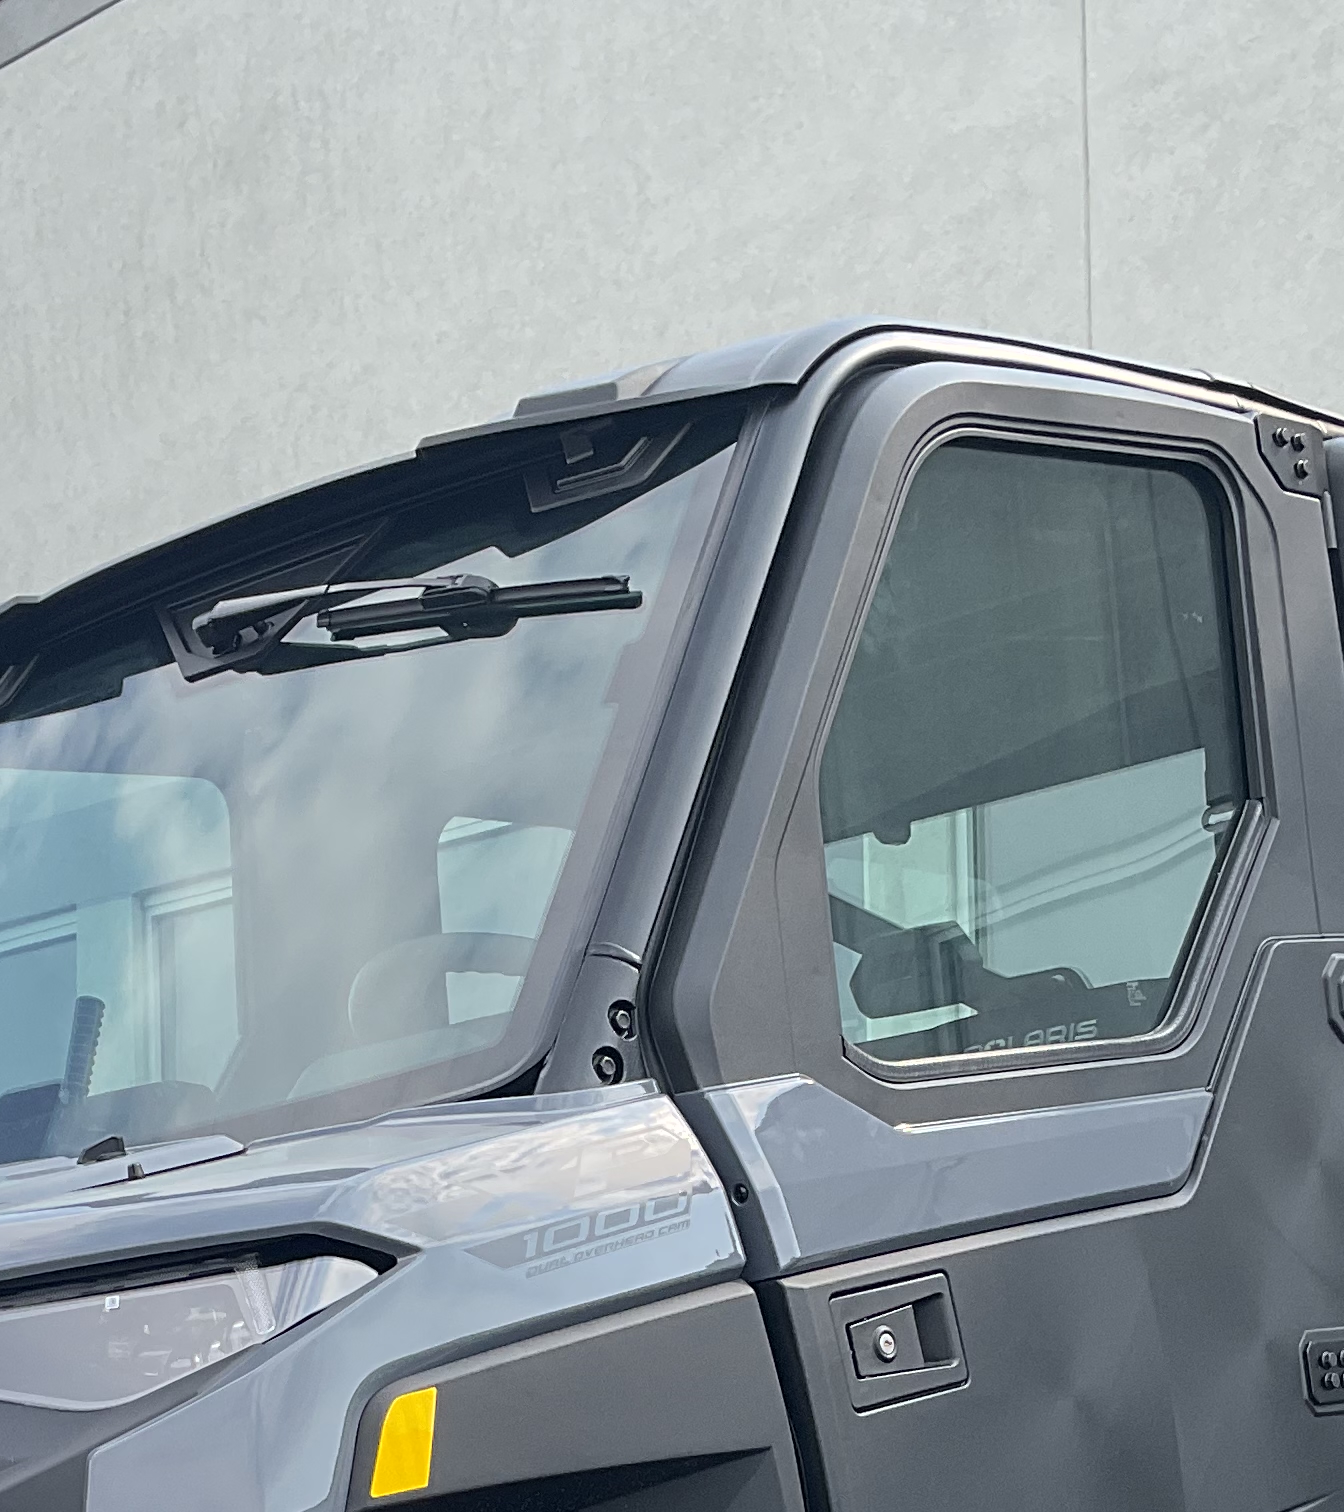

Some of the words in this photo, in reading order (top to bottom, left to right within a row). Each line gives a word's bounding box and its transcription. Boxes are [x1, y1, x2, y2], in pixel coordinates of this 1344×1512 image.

[523, 1192, 690, 1259] 1000
[525, 1255, 571, 1279] DUAL
[574, 1229, 655, 1261] OVERHEAD
[658, 1219, 691, 1236] CAM
